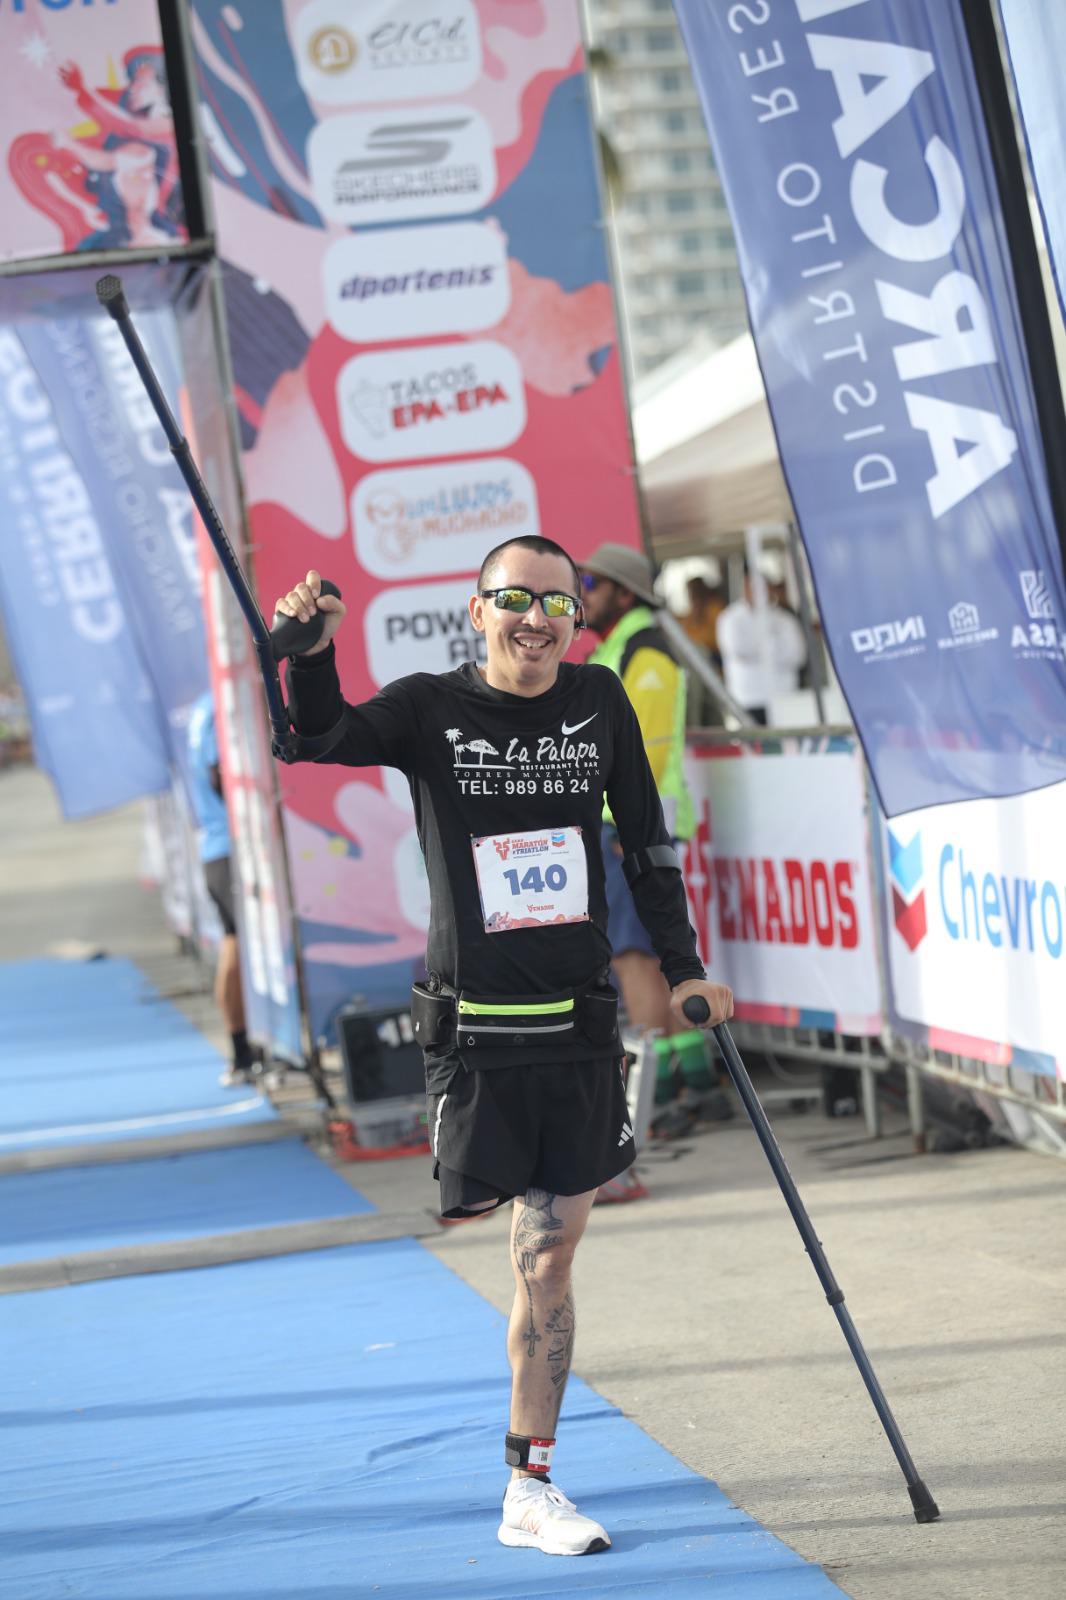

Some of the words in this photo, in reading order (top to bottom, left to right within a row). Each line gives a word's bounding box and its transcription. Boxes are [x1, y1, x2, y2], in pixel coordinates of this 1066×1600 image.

[339, 264, 496, 302] dportenis
[389, 364, 477, 398] TACOS
[385, 607, 478, 643] POW
[505, 737, 530, 763] La
[536, 736, 600, 768] Palapa
[520, 763, 572, 771] RESTAURANT
[453, 770, 512, 778] TORRES
[523, 769, 600, 778] MAZATLAN
[458, 780, 499, 795] TEL:
[505, 780, 537, 795] 989
[543, 779, 565, 794] 86
[570, 779, 590, 793] 24
[503, 864, 567, 896] 140
[938, 843, 1066, 960] Chevro
